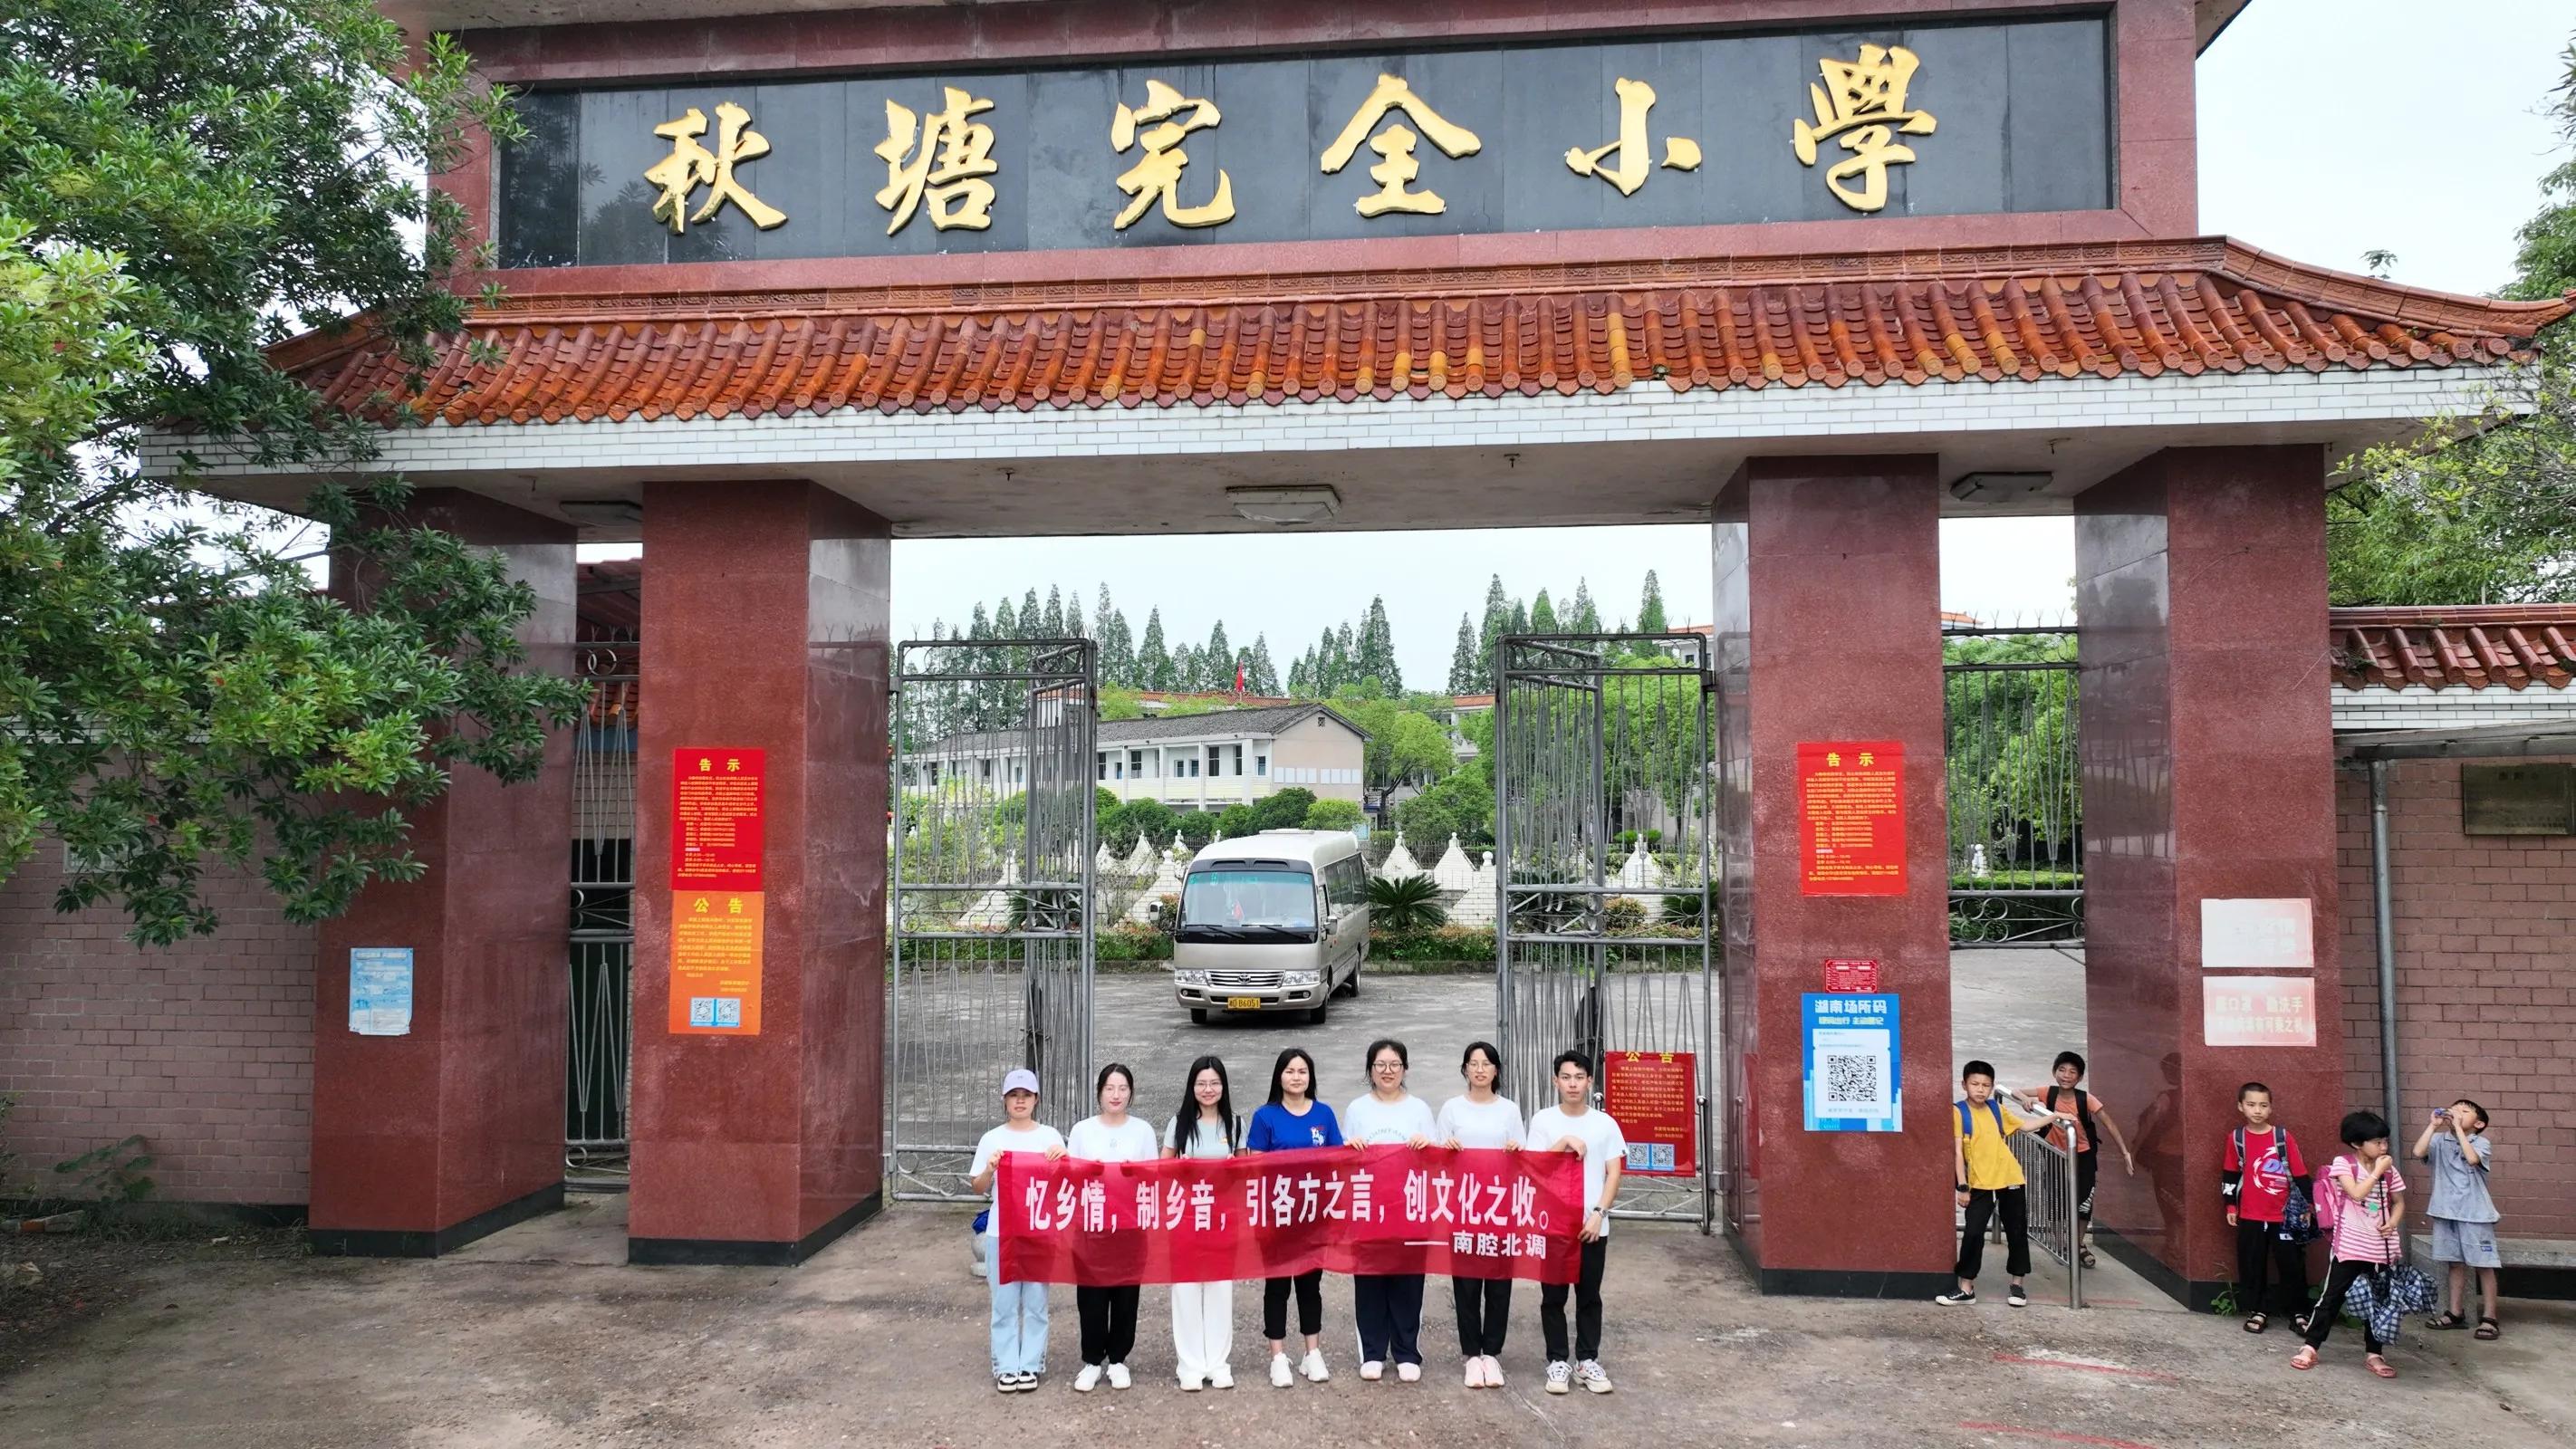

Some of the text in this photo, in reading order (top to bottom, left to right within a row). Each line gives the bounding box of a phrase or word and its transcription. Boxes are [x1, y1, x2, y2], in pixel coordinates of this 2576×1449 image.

[645, 43, 1937, 235] 秋塘完全小學
[699, 758, 741, 772] 告示
[1826, 752, 1875, 768] 告示
[694, 897, 744, 914] 公告
